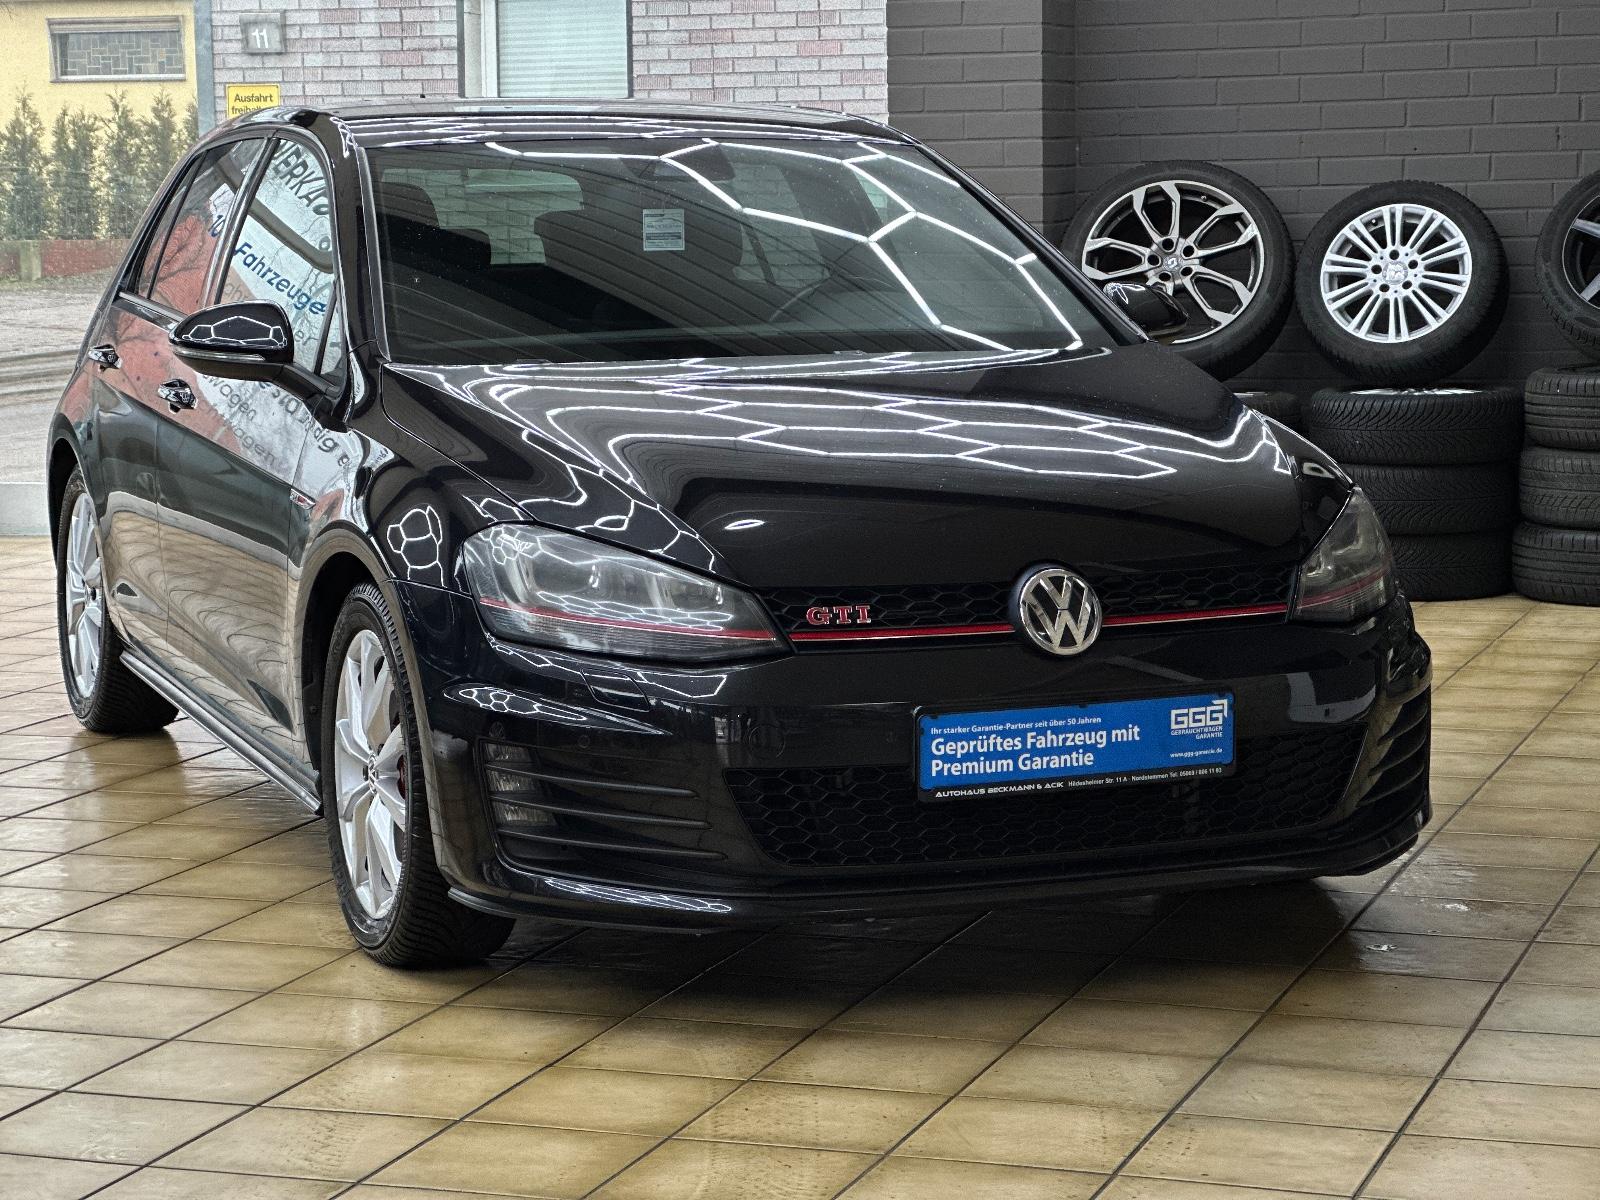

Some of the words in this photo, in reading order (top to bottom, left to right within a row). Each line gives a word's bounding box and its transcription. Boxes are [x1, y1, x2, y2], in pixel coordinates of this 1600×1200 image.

[251, 28, 269, 49] 11
[233, 93, 274, 103] Ausfahrt
[805, 605, 872, 625] GTI
[931, 727, 941, 735] Ihr
[943, 726, 969, 734] starker
[971, 722, 1033, 732] Garantie-Partner
[1034, 720, 1048, 728] seit
[1049, 719, 1066, 727] über
[1076, 716, 1101, 725] Jahren
[1170, 705, 1223, 729] GGG
[931, 734, 1022, 758] Geprüftes
[1026, 729, 1107, 749] Fahrzeug
[1111, 723, 1141, 743] mit
[1195, 732, 1223, 741] GARANTIE
[931, 757, 1013, 777] Premium
[1018, 749, 1094, 771] Garantie
[935, 789, 985, 798] AUTOHAUS
[987, 784, 1035, 794] BECKMANN
